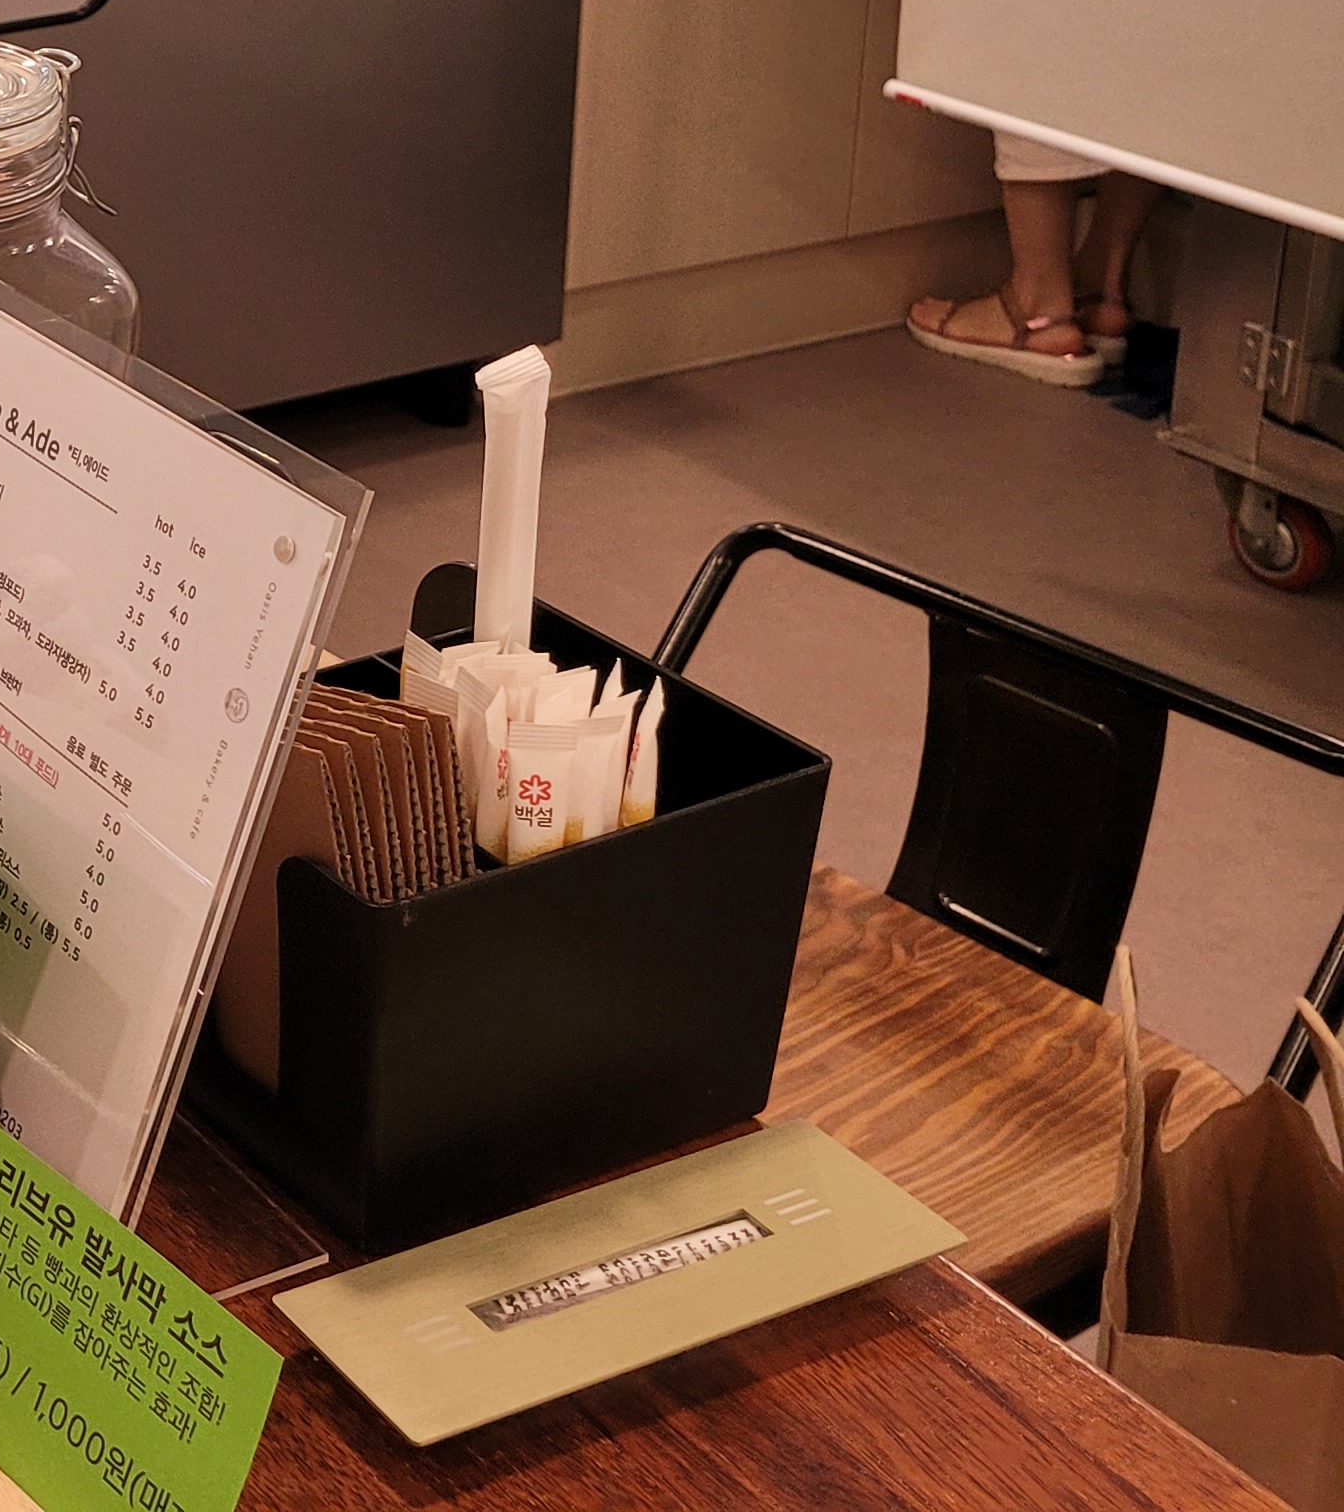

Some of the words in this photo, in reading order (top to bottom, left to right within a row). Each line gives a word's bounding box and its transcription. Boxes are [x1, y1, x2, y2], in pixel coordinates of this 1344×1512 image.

[4, 407, 19, 436] &
[20, 419, 59, 460] Ade
[154, 514, 174, 537] hot
[189, 536, 205, 558] ice
[142, 554, 161, 575] 3.5
[177, 579, 196, 599] 4.0
[135, 580, 155, 602] 3.5
[169, 604, 188, 625] 4.0
[125, 605, 144, 626] 3.5
[160, 630, 179, 651] 4.0
[4, 608, 31, 640] 모과차,
[34, 631, 90, 683] 도라지생강차)
[98, 679, 117, 701] 5.0
[134, 706, 154, 728] 5.5
[116, 630, 136, 651] 3.5
[151, 656, 171, 677] 4.0
[144, 683, 164, 704] 4.0
[66, 735, 85, 760] 음료
[88, 751, 108, 778] 별도
[111, 770, 132, 797] 주문
[101, 812, 120, 835] 5.0
[514, 804, 553, 829] 백설
[95, 839, 114, 862] 5.0
[85, 864, 104, 886] 4.0
[79, 889, 98, 913] 5.0
[9, 892, 28, 915] 2.5
[61, 937, 80, 961] 5.5
[13, 927, 32, 949] 0.5
[73, 916, 92, 939] 6.0
[20, 1234, 41, 1265] 등
[43, 1252, 99, 1317] 빵과의
[90, 1302, 176, 1384] 환상적인
[176, 1370, 225, 1425] 조합!
[167, 1310, 227, 1378] 소스
[72, 1318, 152, 1402] 잡아주는
[148, 1390, 202, 1443] 효과!
[37, 1381, 185, 1512] 1,000원(매
